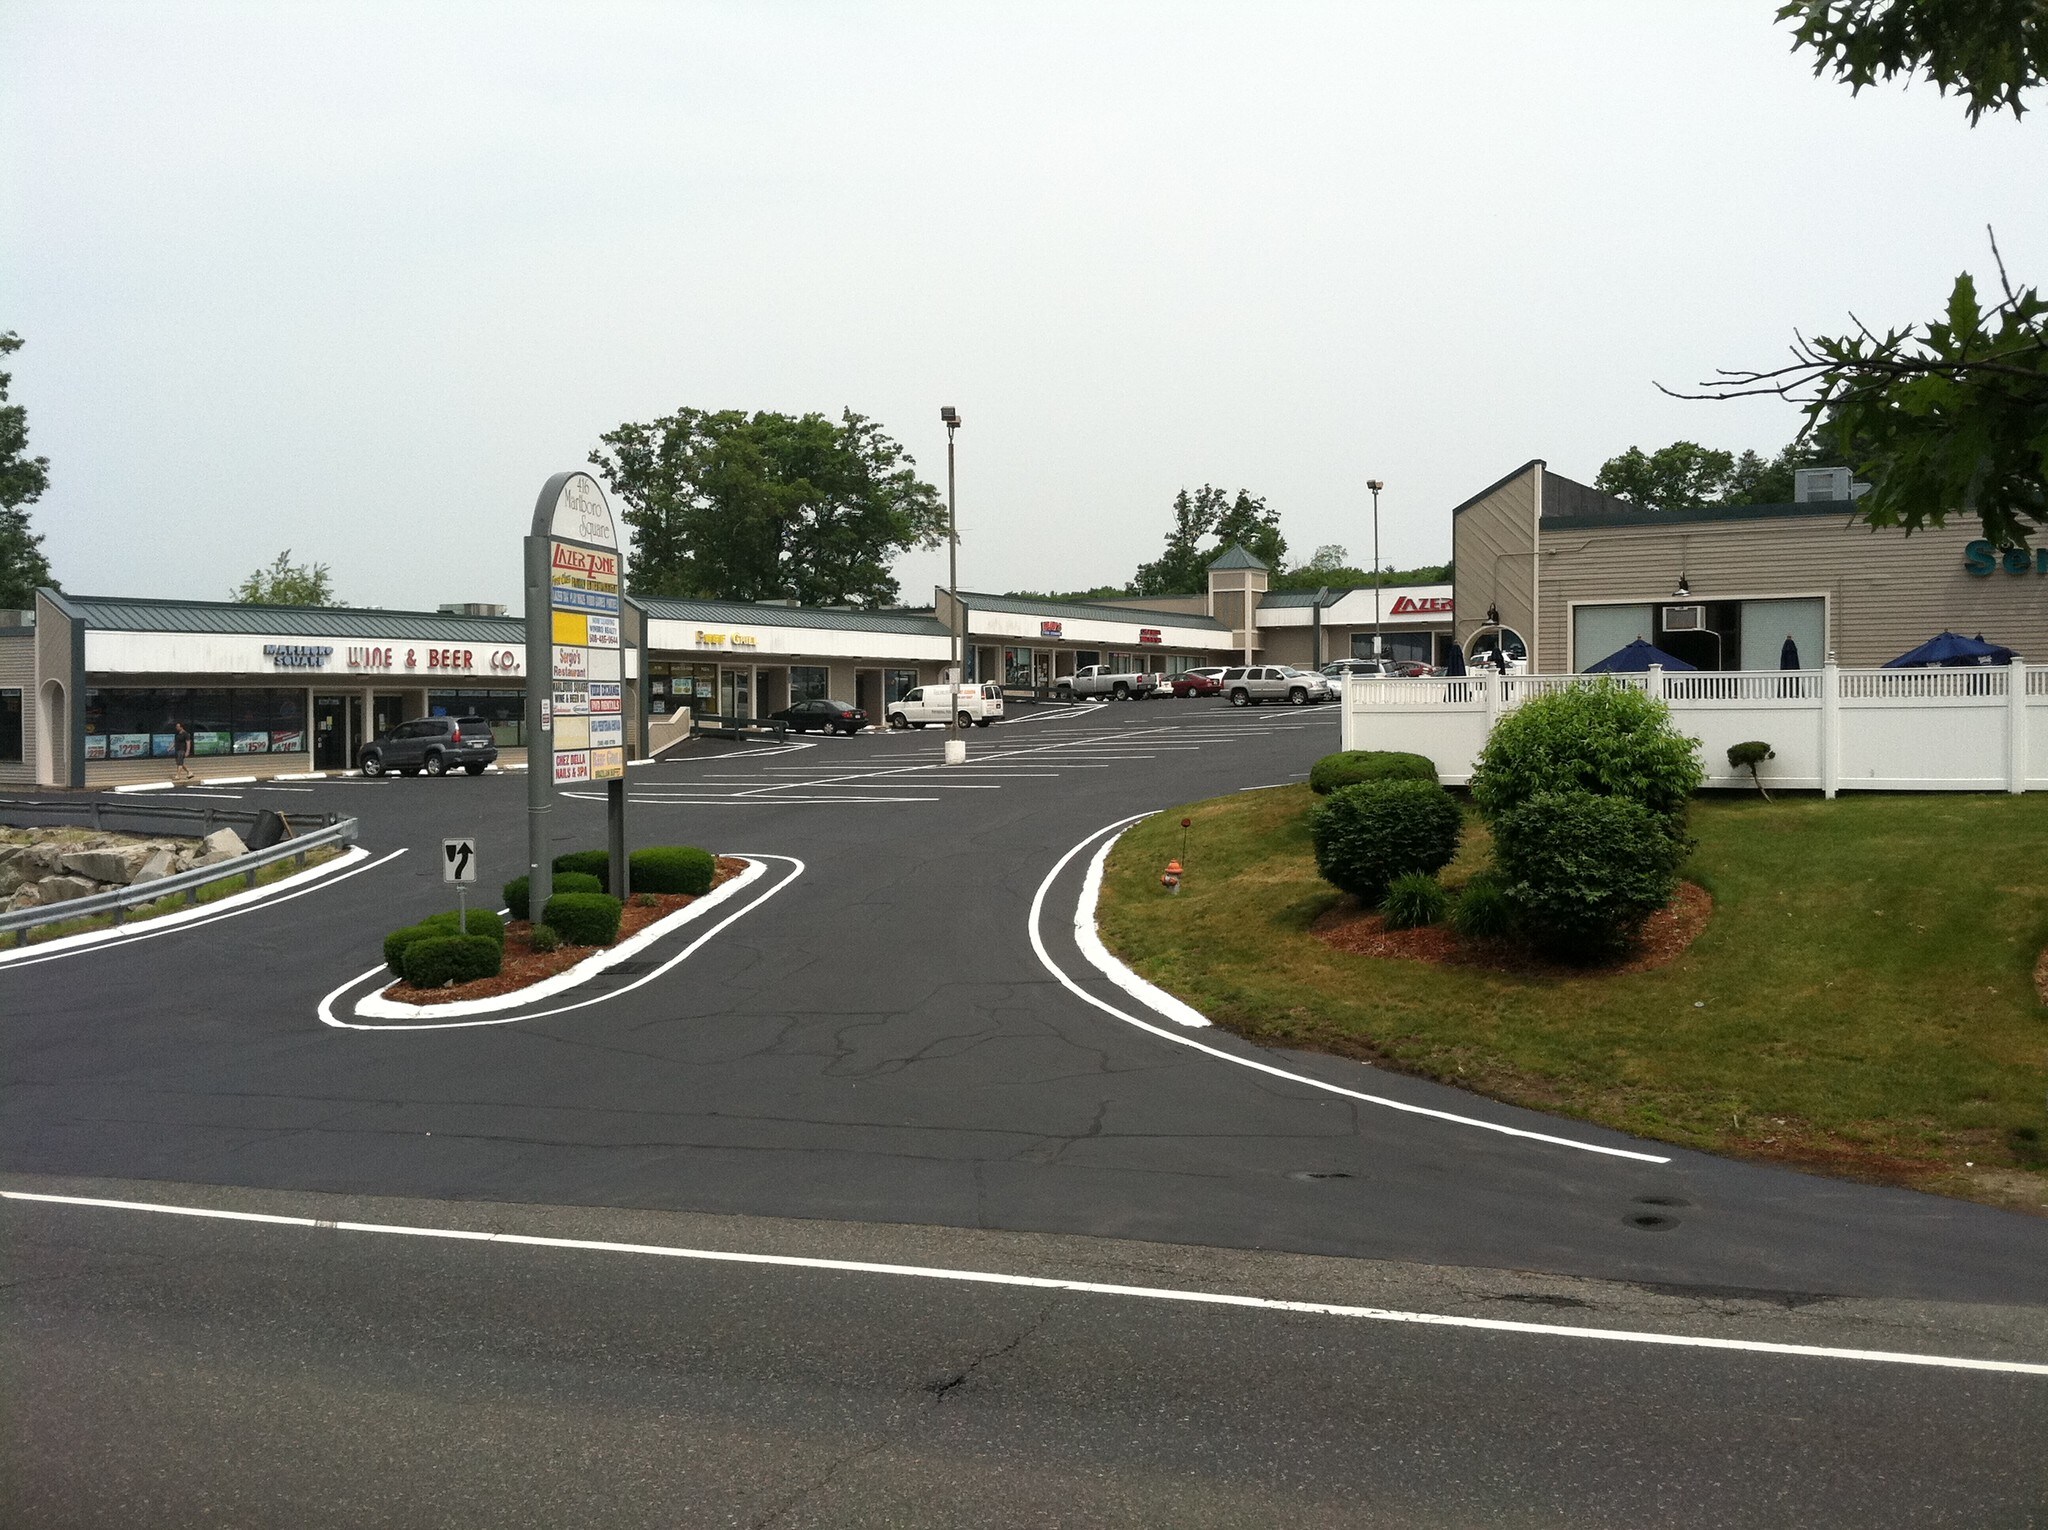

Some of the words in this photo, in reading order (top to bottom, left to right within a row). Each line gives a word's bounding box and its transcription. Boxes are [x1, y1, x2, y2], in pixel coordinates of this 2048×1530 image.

[564, 487, 602, 518] Marlboro
[579, 514, 610, 542] Square
[552, 543, 586, 569] LAZER
[586, 553, 616, 579] ZONE
[1390, 596, 1453, 614] LAZER
[263, 645, 334, 656] MARLBORO
[273, 656, 326, 667] SQUARE
[348, 646, 393, 667] WINE
[405, 648, 417, 668] &
[427, 648, 474, 669] BEER
[491, 650, 520, 670] CO.
[560, 648, 581, 668] Sergio's
[553, 665, 586, 678] Restaurant
[555, 694, 565, 703] WINE
[570, 694, 580, 703] BEER
[591, 700, 601, 711] DVD
[601, 699, 620, 711] RENTALS
[556, 755, 570, 766] CHEZ
[570, 753, 585, 765] DELLA
[556, 768, 571, 779] NAILS
[571, 767, 577, 777] &
[577, 766, 588, 777] SPA
